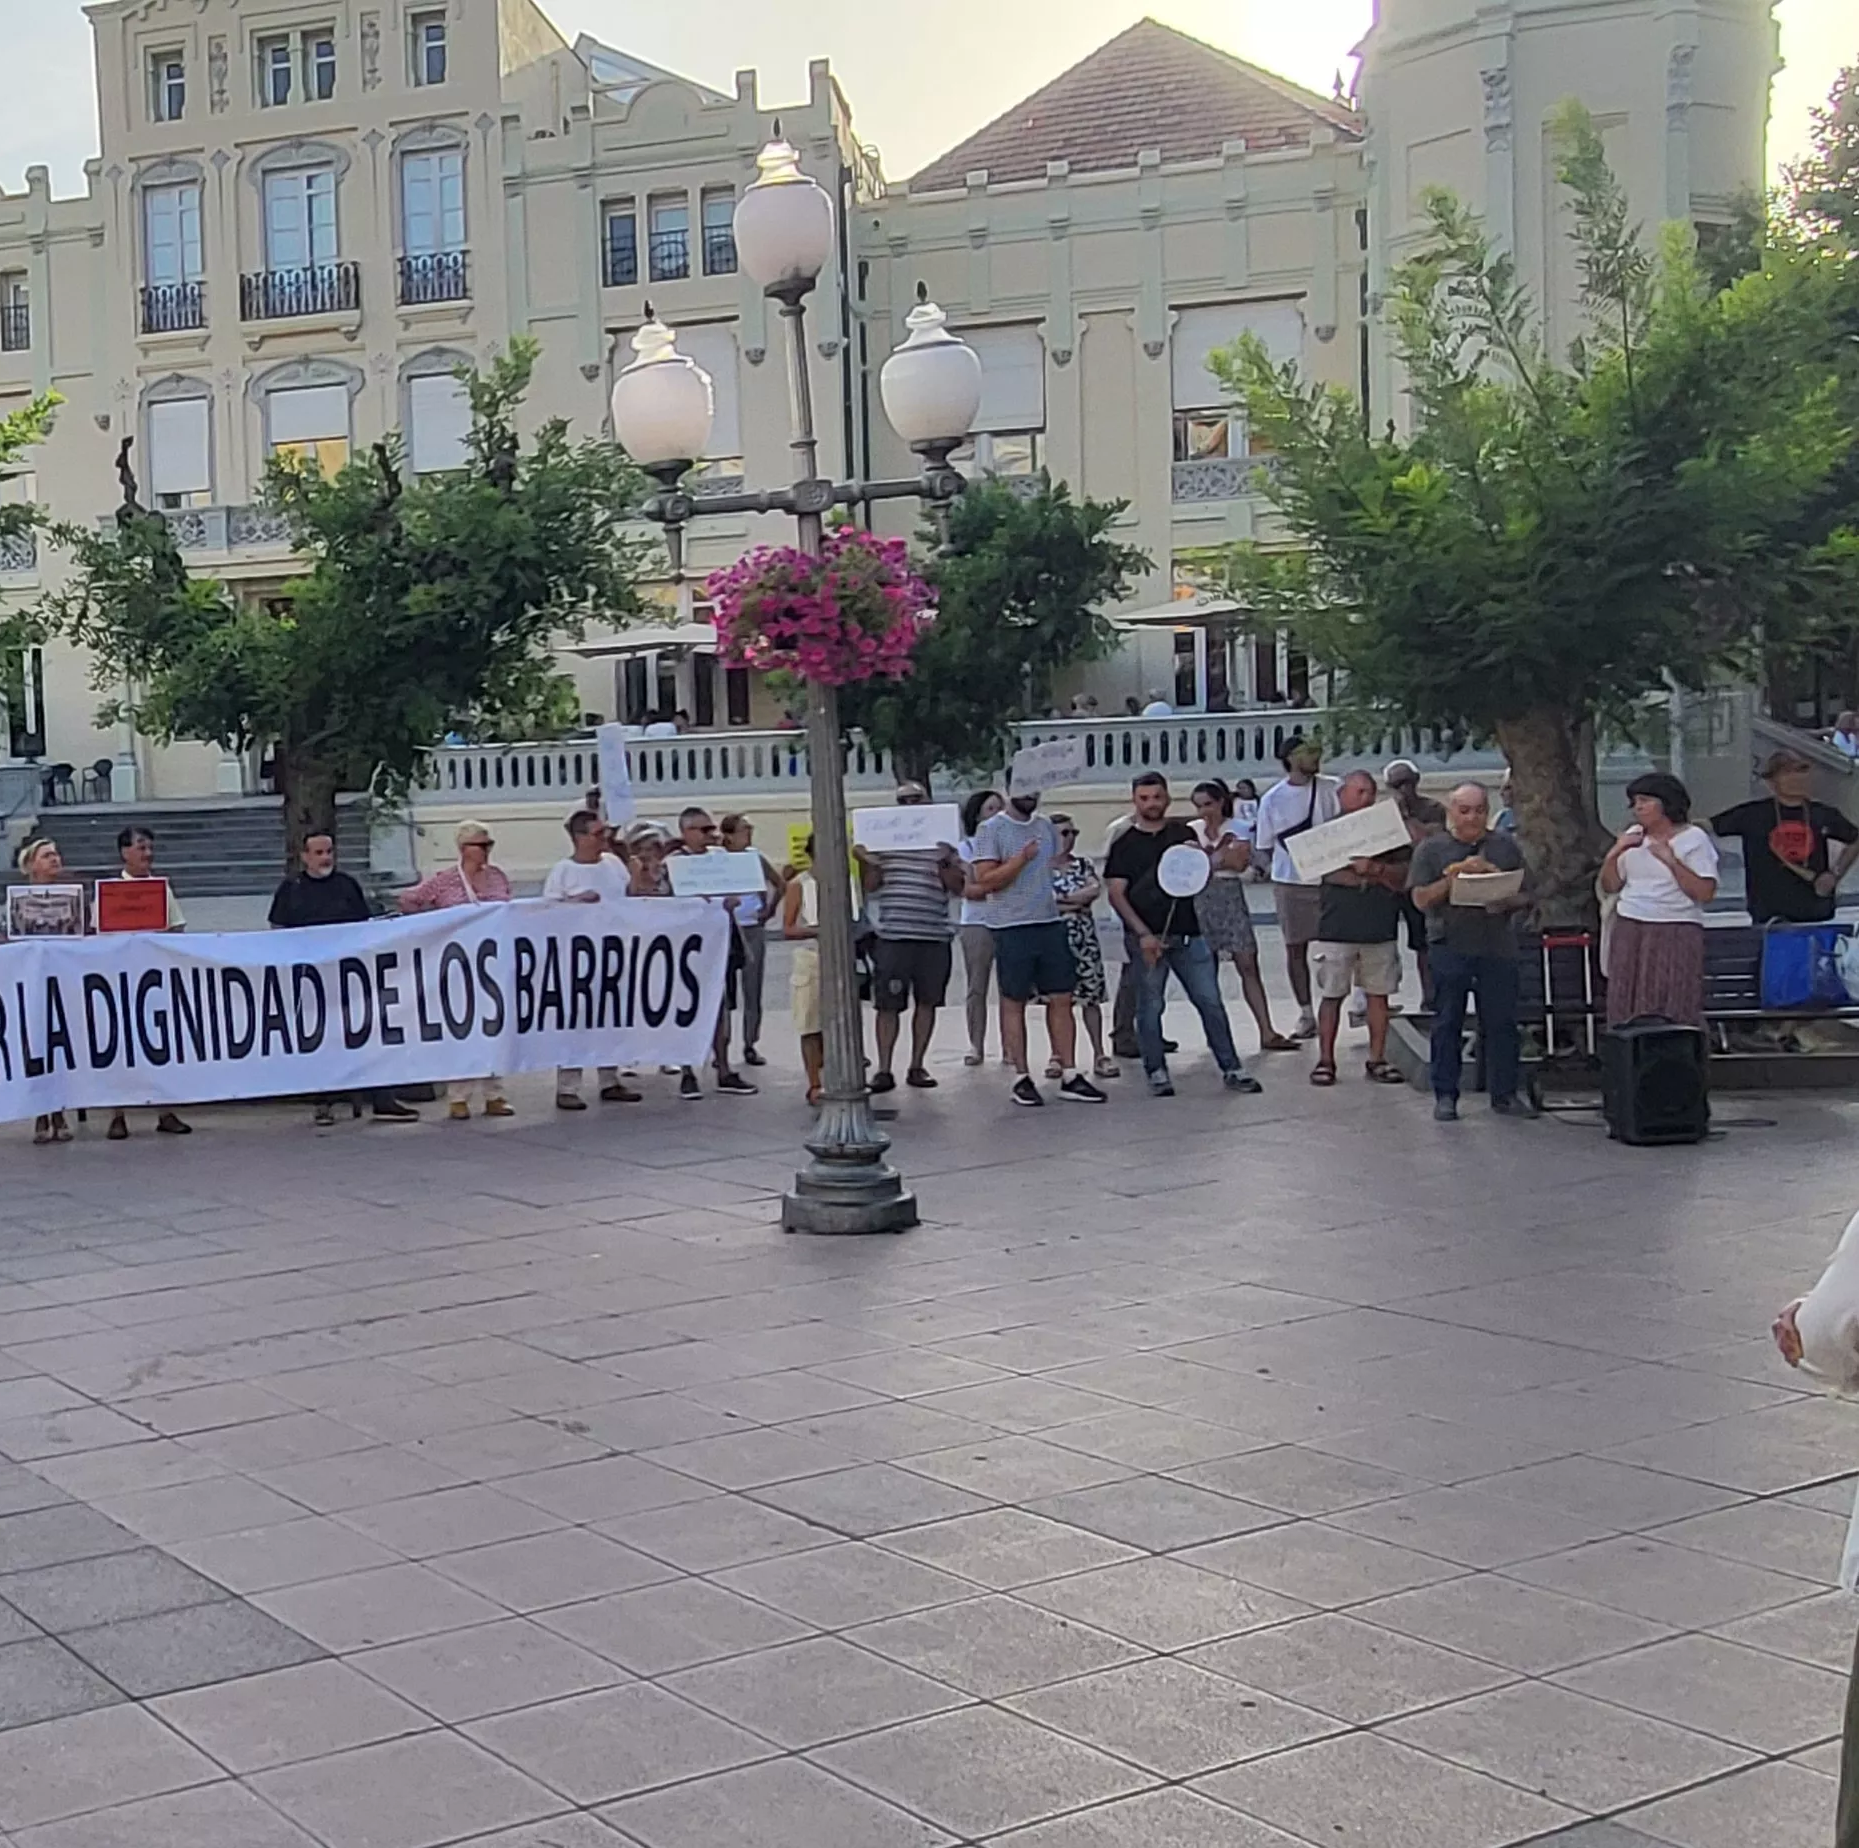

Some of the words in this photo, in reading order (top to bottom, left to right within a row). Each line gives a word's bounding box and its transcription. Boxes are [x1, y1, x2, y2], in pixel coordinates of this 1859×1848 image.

[15, 976, 76, 1079] LA
[83, 963, 328, 1071] DIGNIDAD
[339, 951, 406, 1050] DE
[412, 937, 506, 1043] LOS
[513, 933, 703, 1035] BARRIOS
